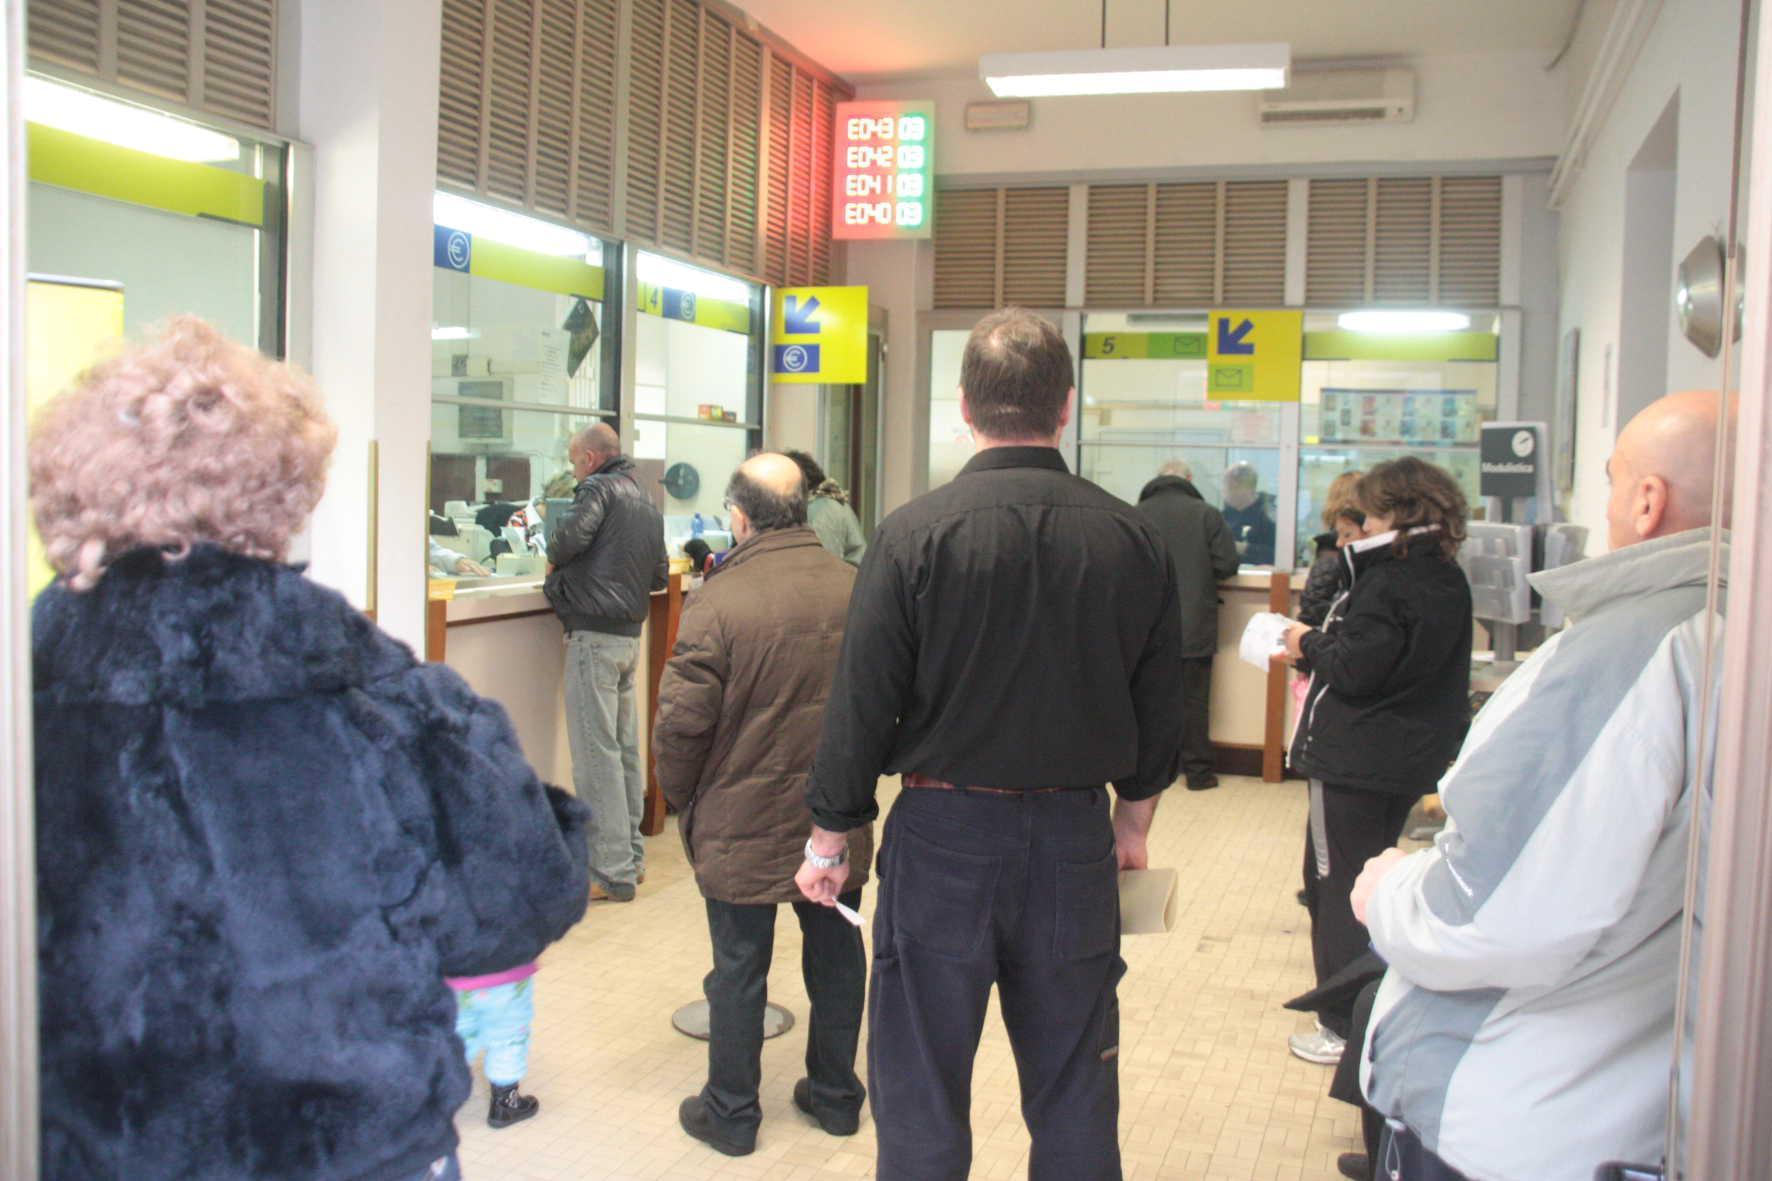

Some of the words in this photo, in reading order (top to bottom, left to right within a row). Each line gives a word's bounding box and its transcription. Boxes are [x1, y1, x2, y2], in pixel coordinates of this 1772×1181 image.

[847, 117, 894, 140] E043
[898, 116, 925, 140] 03
[847, 146, 893, 168] E042
[897, 145, 925, 168] 03
[846, 174, 893, 196] E041
[845, 202, 892, 225] E040
[1101, 336, 1116, 354] 5
